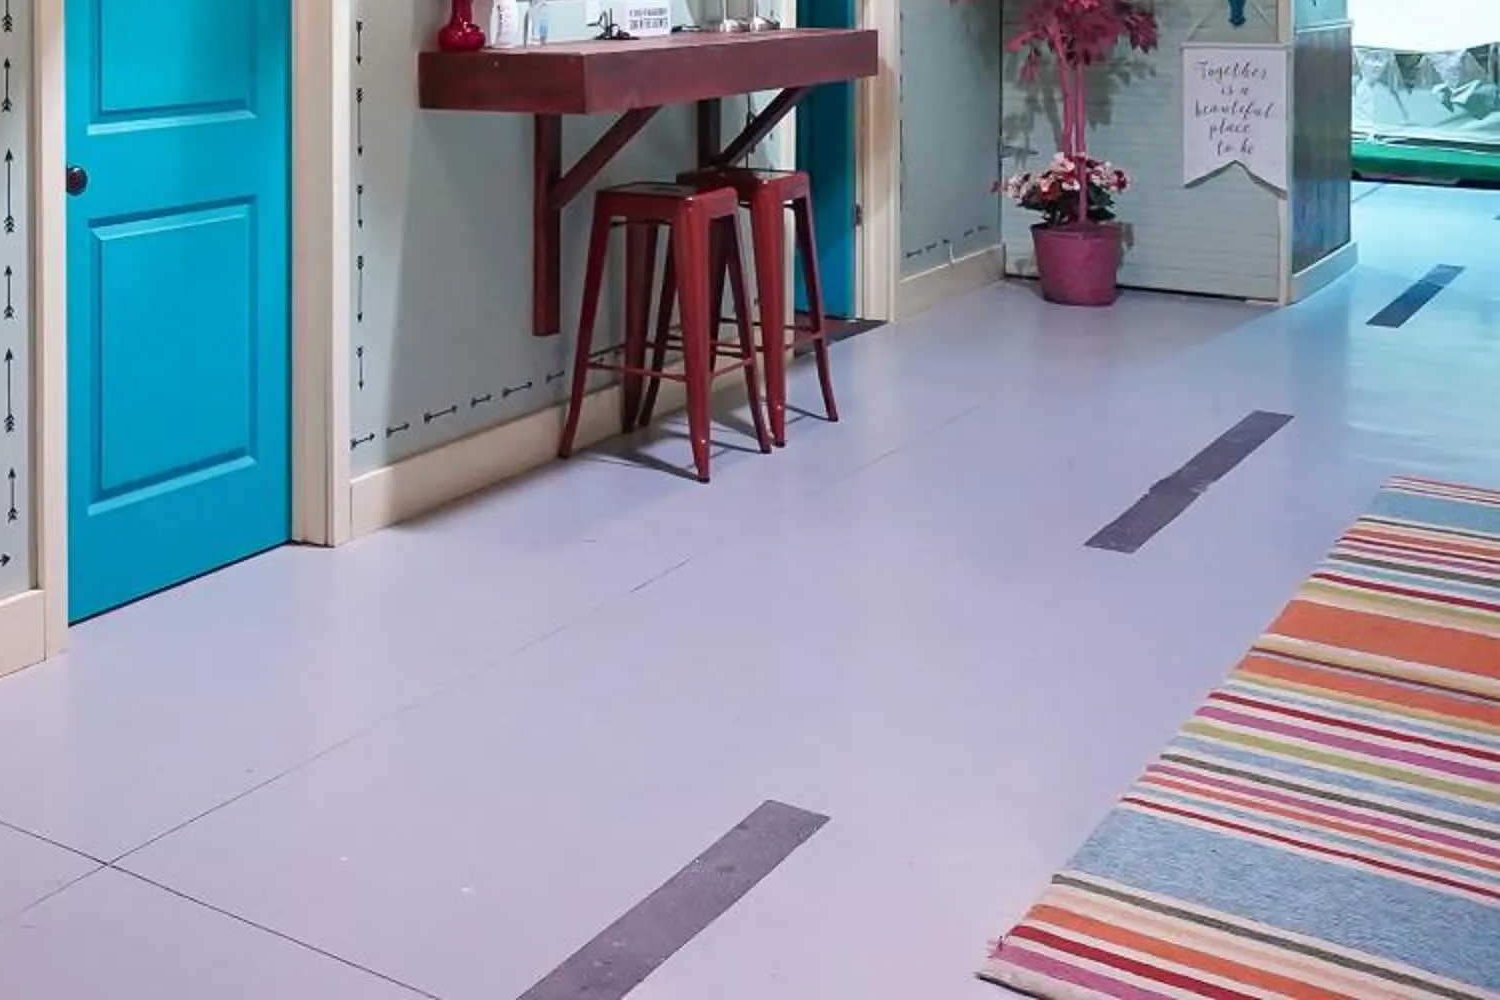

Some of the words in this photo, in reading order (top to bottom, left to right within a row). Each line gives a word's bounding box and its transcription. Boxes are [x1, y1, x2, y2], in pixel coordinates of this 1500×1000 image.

[1194, 60, 1269, 84] Together
[1220, 86, 1234, 96] is
[1240, 86, 1250, 96] a
[1194, 99, 1274, 120] beautiful
[1209, 118, 1251, 140] place
[1216, 139, 1234, 156] to
[1240, 138, 1254, 155] be
